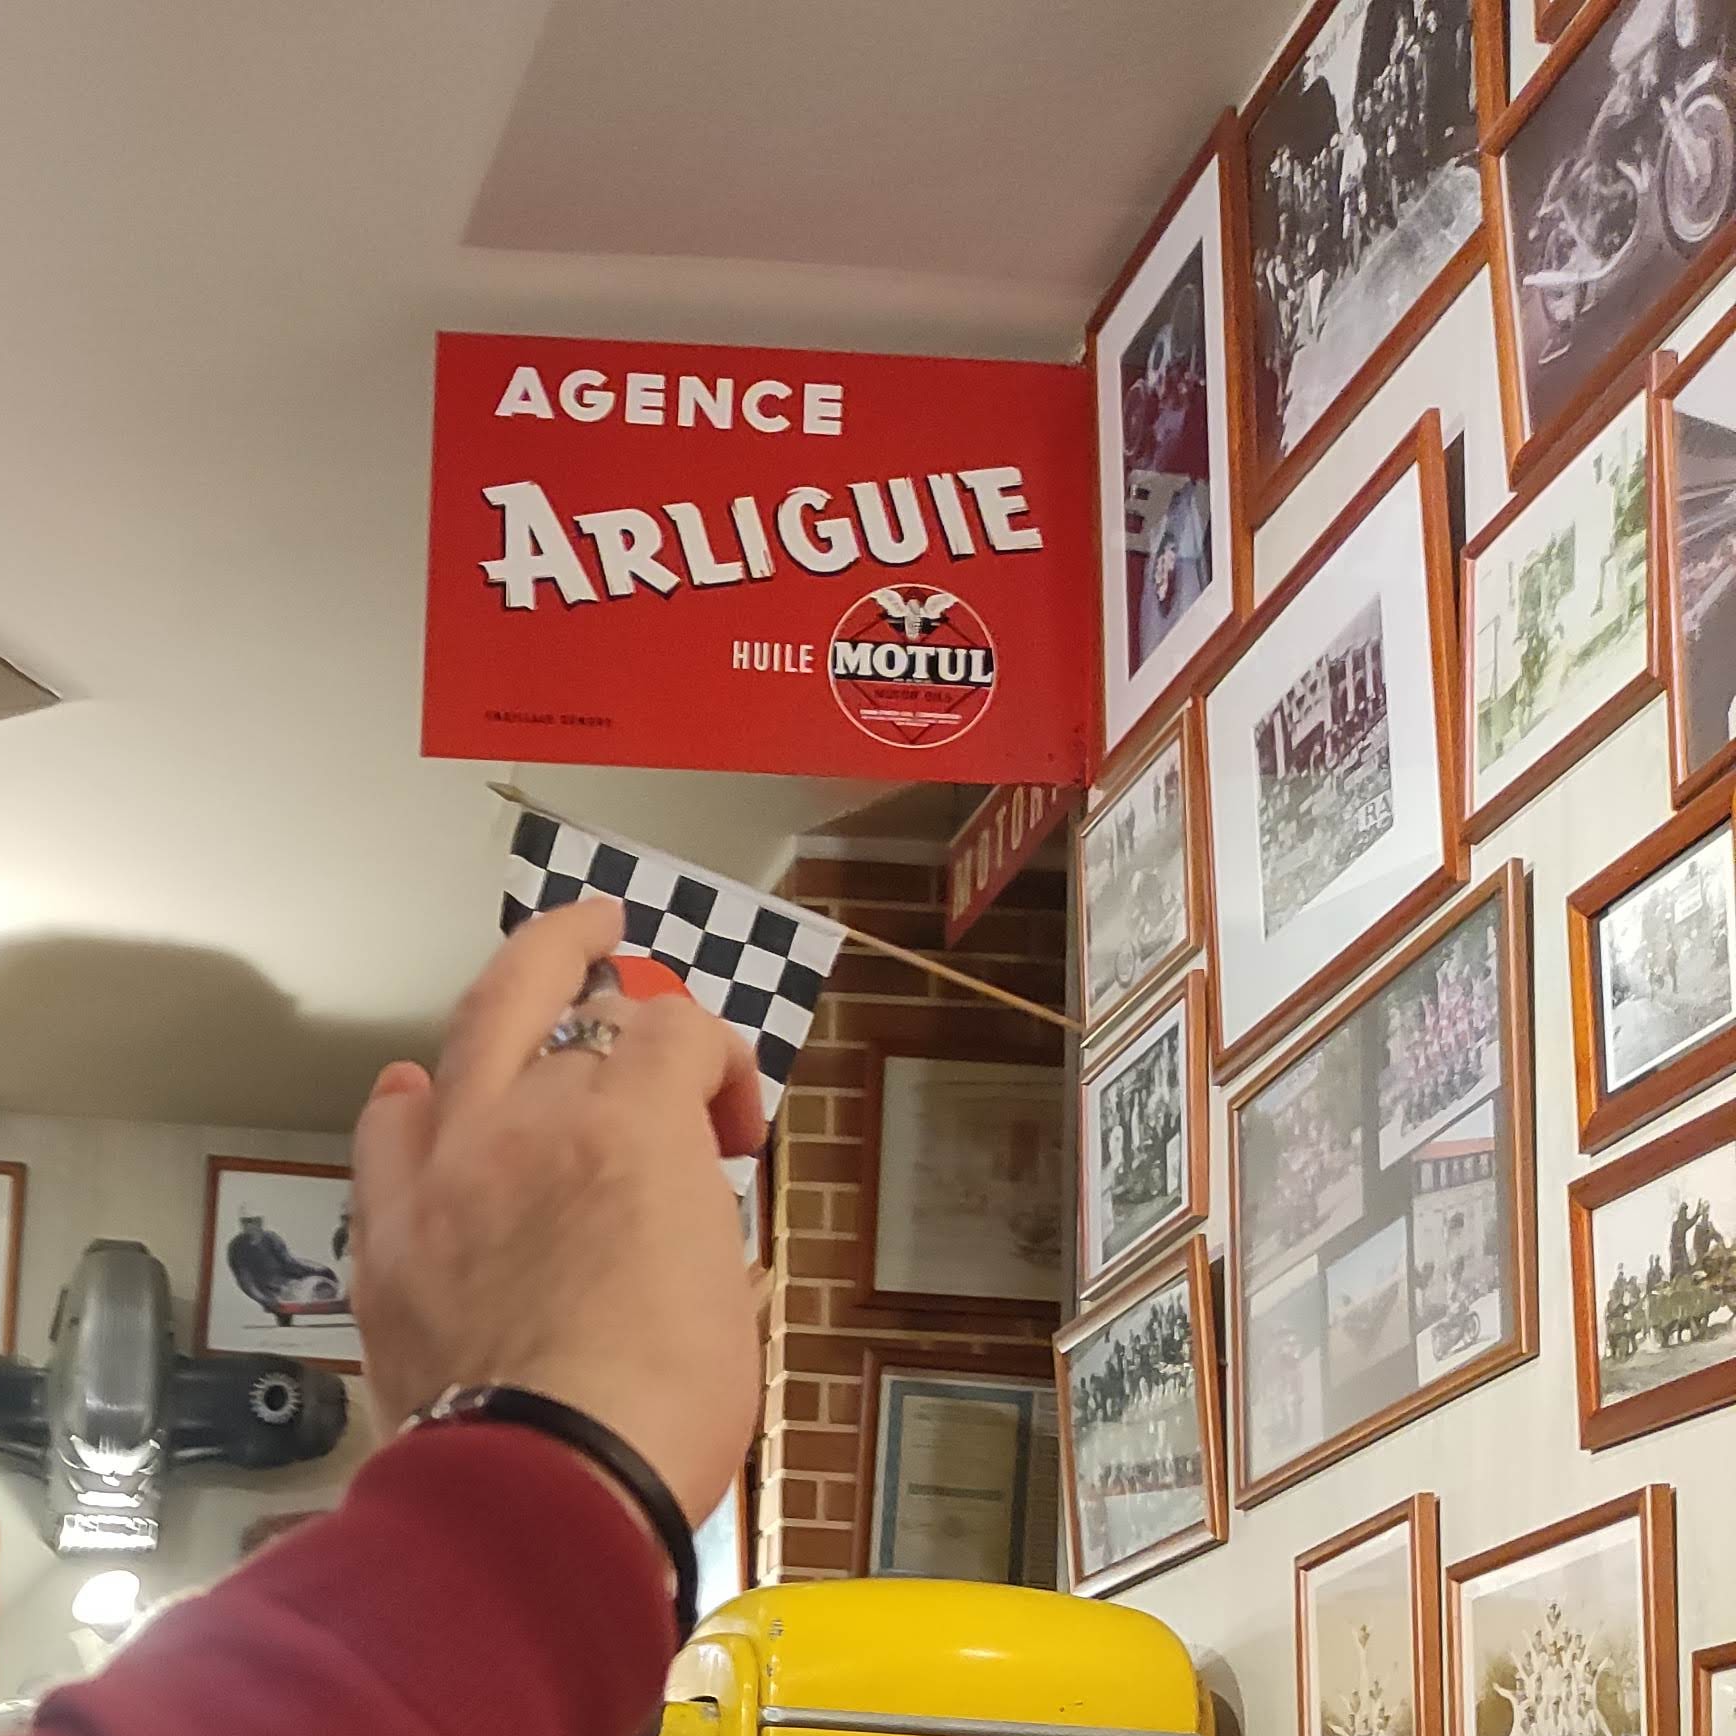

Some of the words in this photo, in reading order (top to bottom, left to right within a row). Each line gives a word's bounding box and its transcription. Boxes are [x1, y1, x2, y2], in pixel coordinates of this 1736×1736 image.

[494, 366, 844, 436] AGENCE
[479, 465, 1044, 611] ARLIGUIE
[732, 640, 815, 674] HUILE
[833, 641, 994, 684] MOTUL
